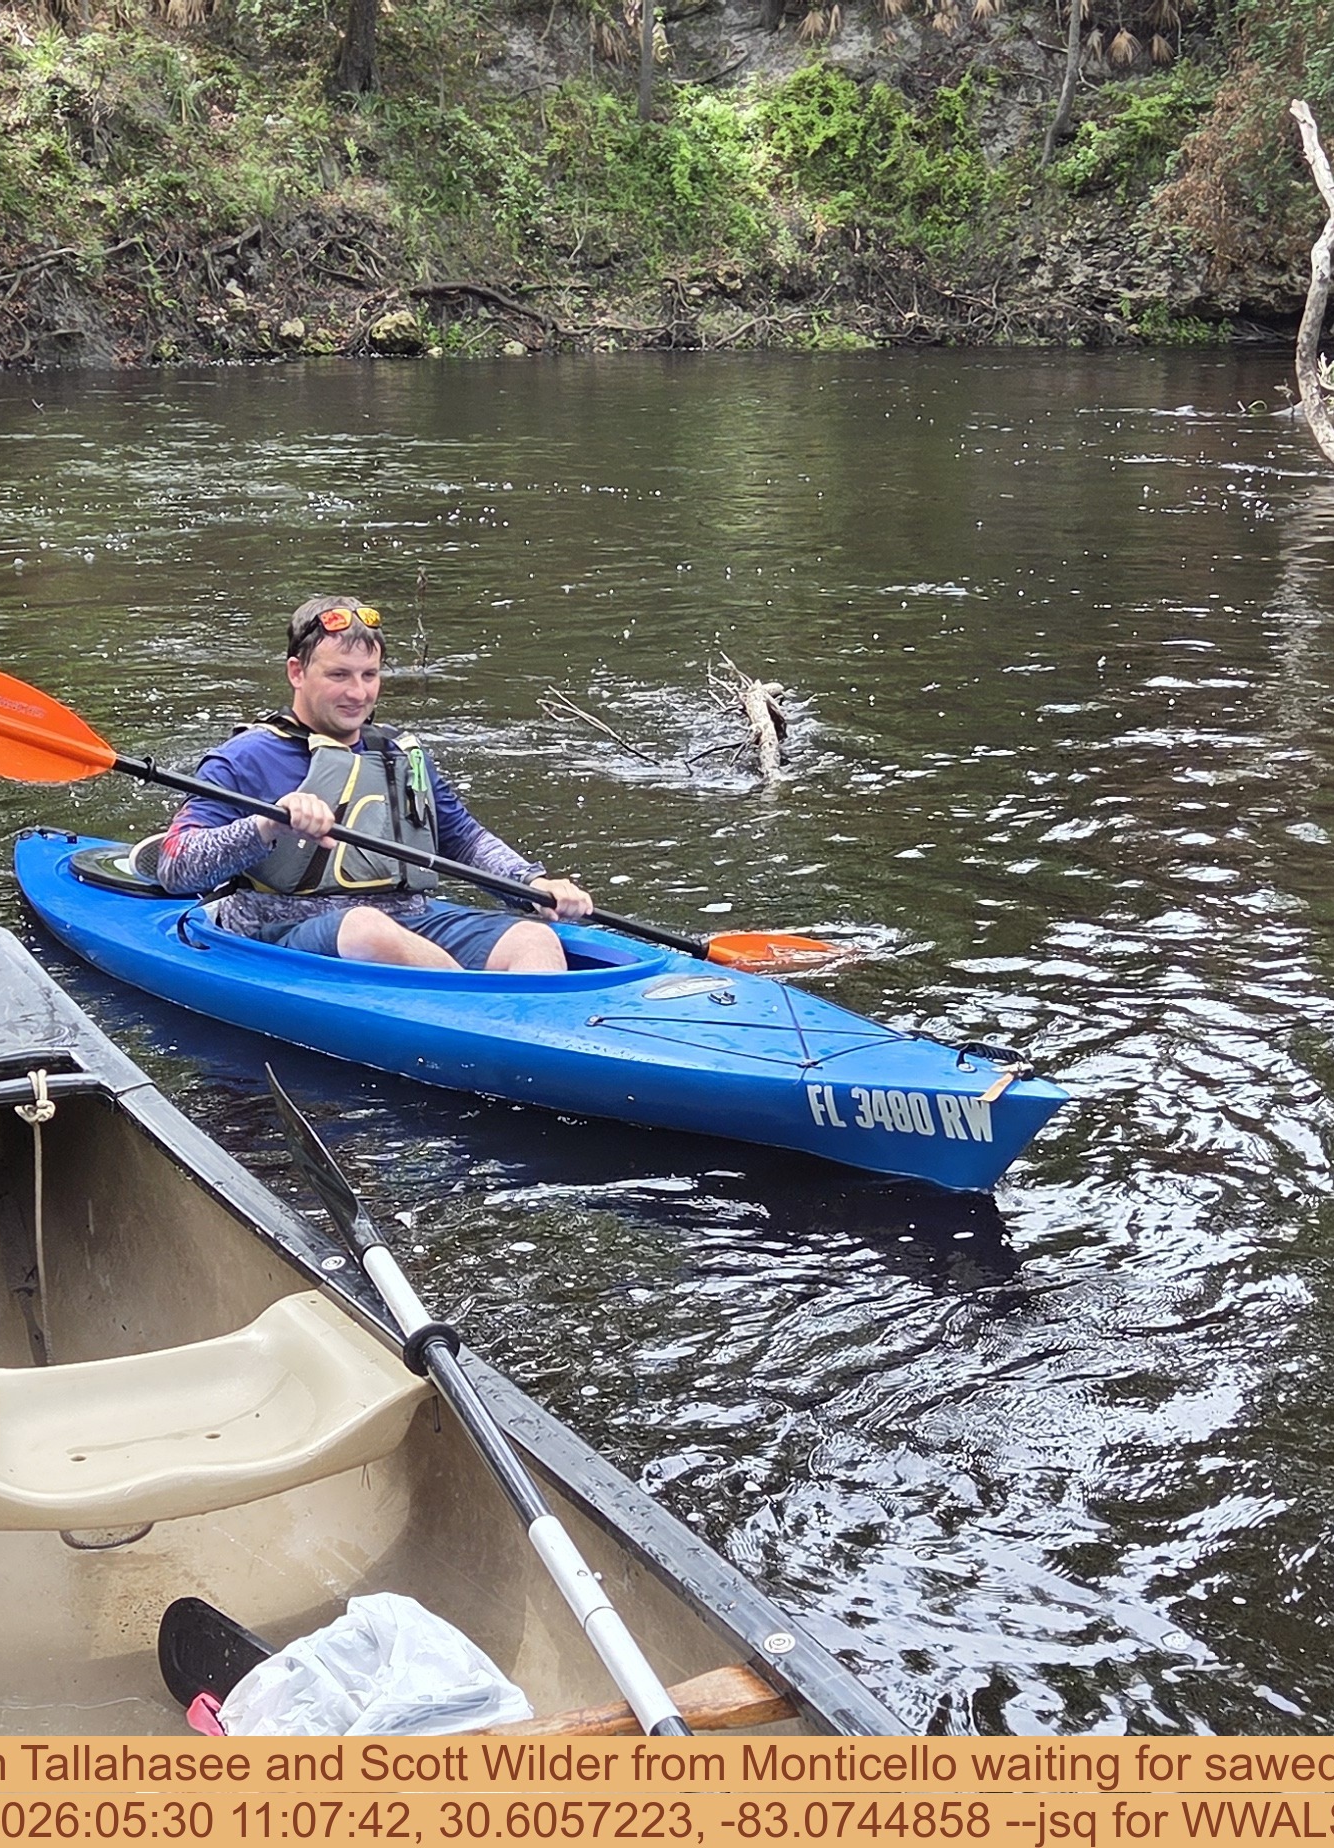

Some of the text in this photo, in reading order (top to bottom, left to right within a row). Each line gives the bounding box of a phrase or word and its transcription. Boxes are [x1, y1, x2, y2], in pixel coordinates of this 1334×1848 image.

[806, 1084, 993, 1142] FL 3480 RW
